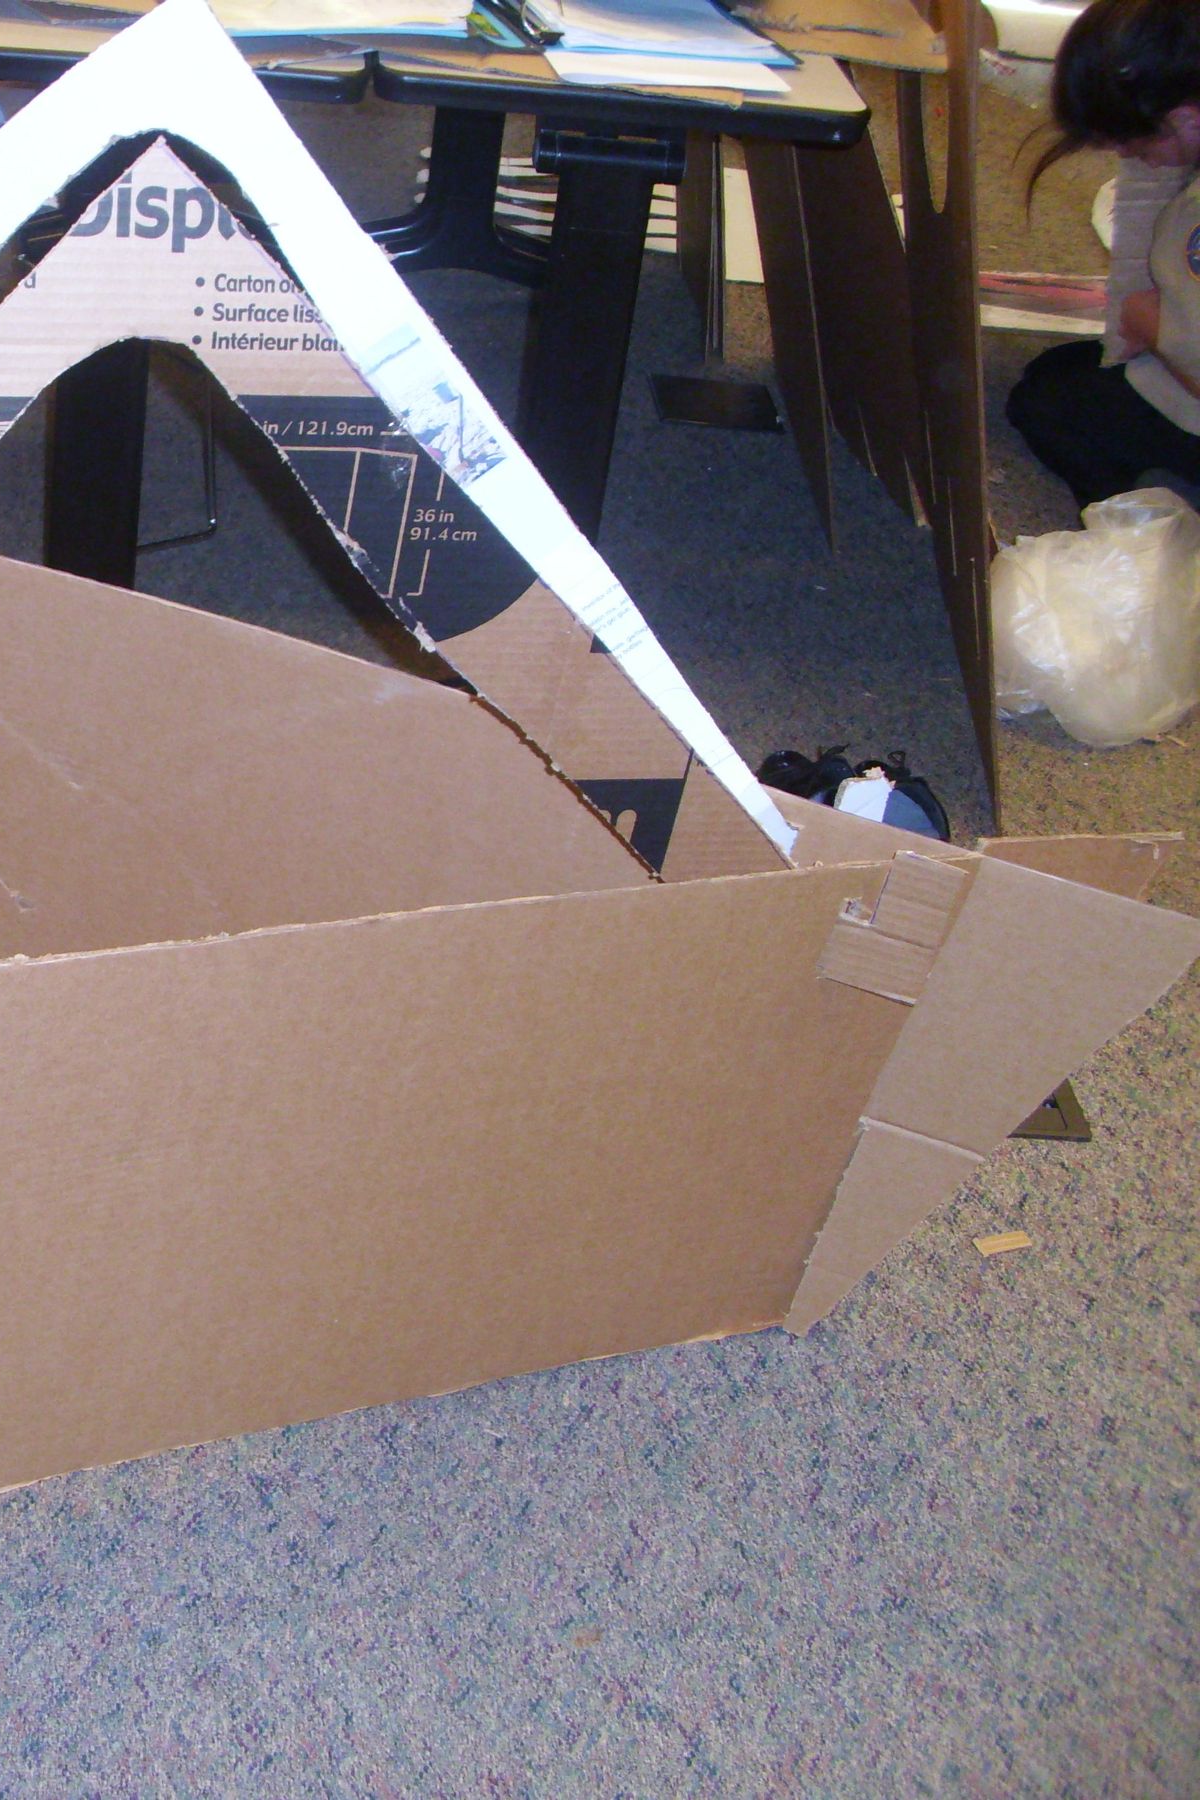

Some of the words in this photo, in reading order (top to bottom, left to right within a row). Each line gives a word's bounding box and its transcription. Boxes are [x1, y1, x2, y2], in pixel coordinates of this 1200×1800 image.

[214, 273, 275, 293] Carton
[212, 303, 289, 323] Surface
[211, 332, 299, 351] Intérieur
[297, 421, 374, 437] 121.9cm
[412, 509, 437, 524] 36
[439, 509, 455, 523] in
[409, 527, 449, 542] 91.4
[450, 530, 477, 542] cm
